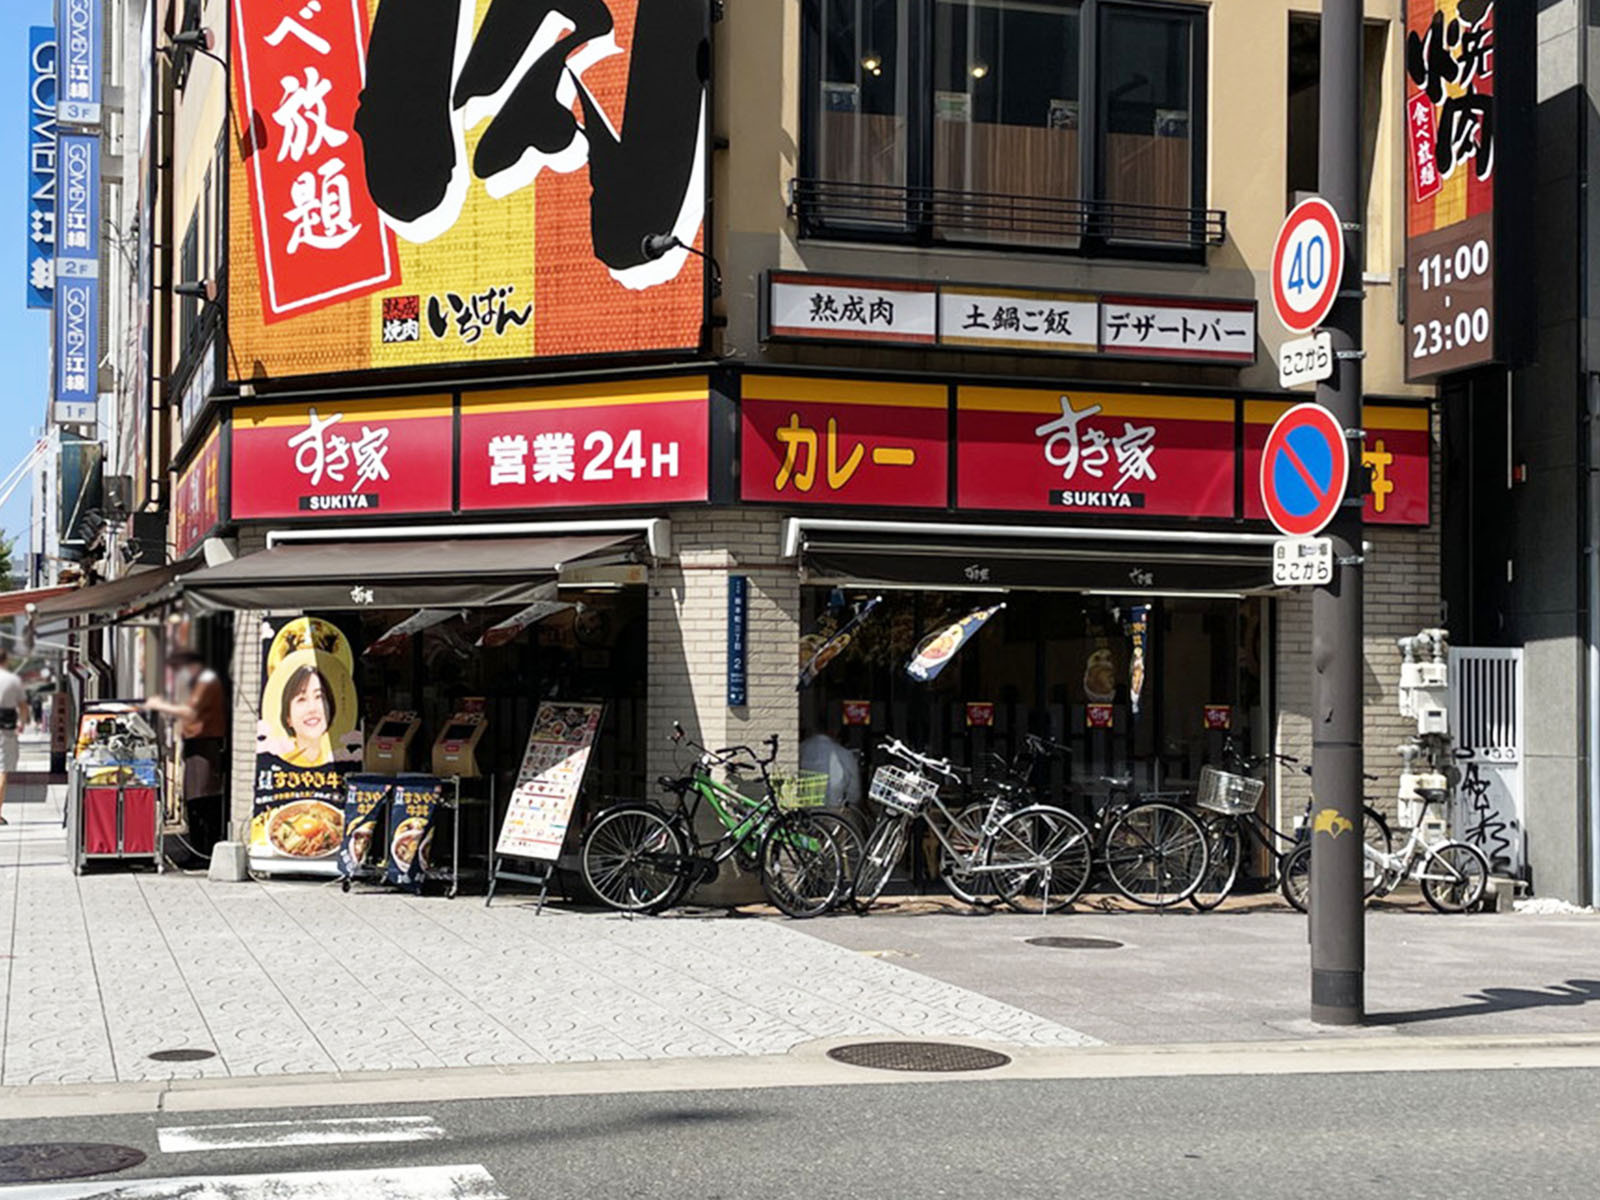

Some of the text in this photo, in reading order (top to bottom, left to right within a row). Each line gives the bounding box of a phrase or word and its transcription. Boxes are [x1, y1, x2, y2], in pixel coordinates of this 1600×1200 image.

[67, 104, 91, 118] 3F
[264, 0, 361, 254] べ放題
[1413, 101, 1437, 188] 食べ放題
[64, 260, 89, 275] 2F
[1287, 235, 1326, 295] 40
[1418, 239, 1489, 291] 11:00
[427, 286, 533, 344] いちばん
[809, 292, 895, 326] 熟成肉
[962, 305, 1073, 337] 土鍋ご飯
[383, 318, 419, 342] 焼肉
[1106, 313, 1248, 344] デザートバー
[1412, 306, 1489, 359] 23:00
[1282, 344, 1328, 376] ここから
[66, 404, 88, 418] 1F
[287, 407, 390, 494] すき家
[773, 412, 916, 493] カレー
[1035, 395, 1157, 491] すき家
[309, 494, 369, 510] SUKIYA
[1061, 491, 1132, 508] SUKIYA
[1275, 560, 1329, 581] ここから
